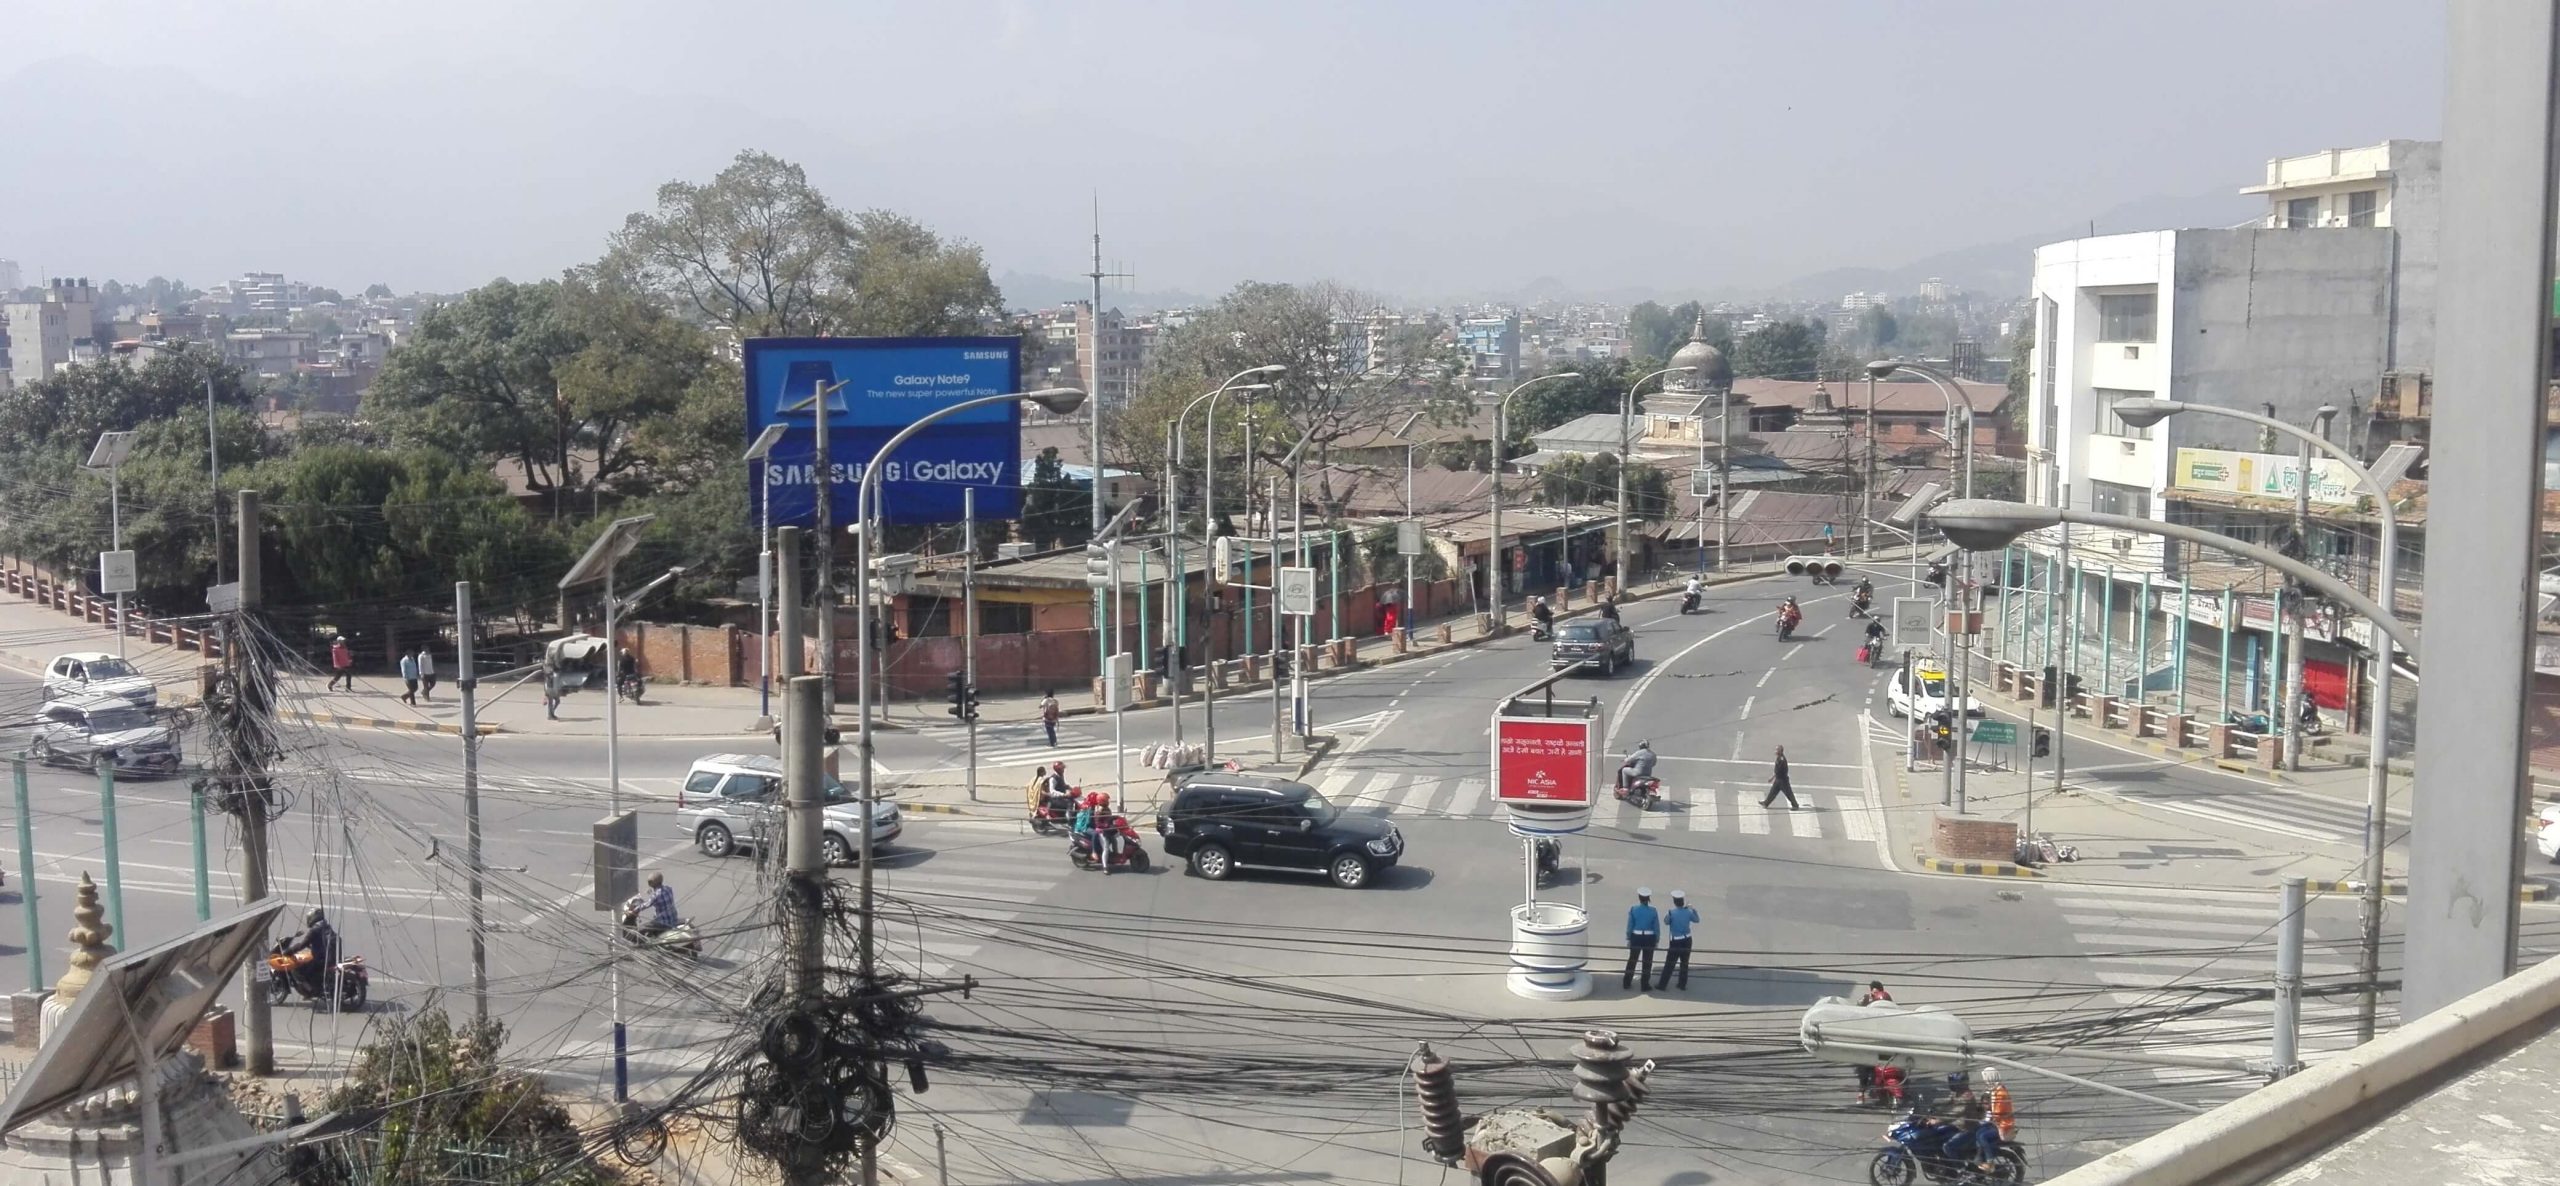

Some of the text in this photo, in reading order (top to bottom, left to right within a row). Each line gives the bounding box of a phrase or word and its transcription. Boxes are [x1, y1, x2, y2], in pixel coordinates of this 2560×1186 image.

[963, 351, 1009, 360] SAMSUNG
[894, 373, 971, 387] Galaxy Note9
[867, 387, 998, 400] The new super powerful Note
[913, 459, 1004, 485] Galaxy
